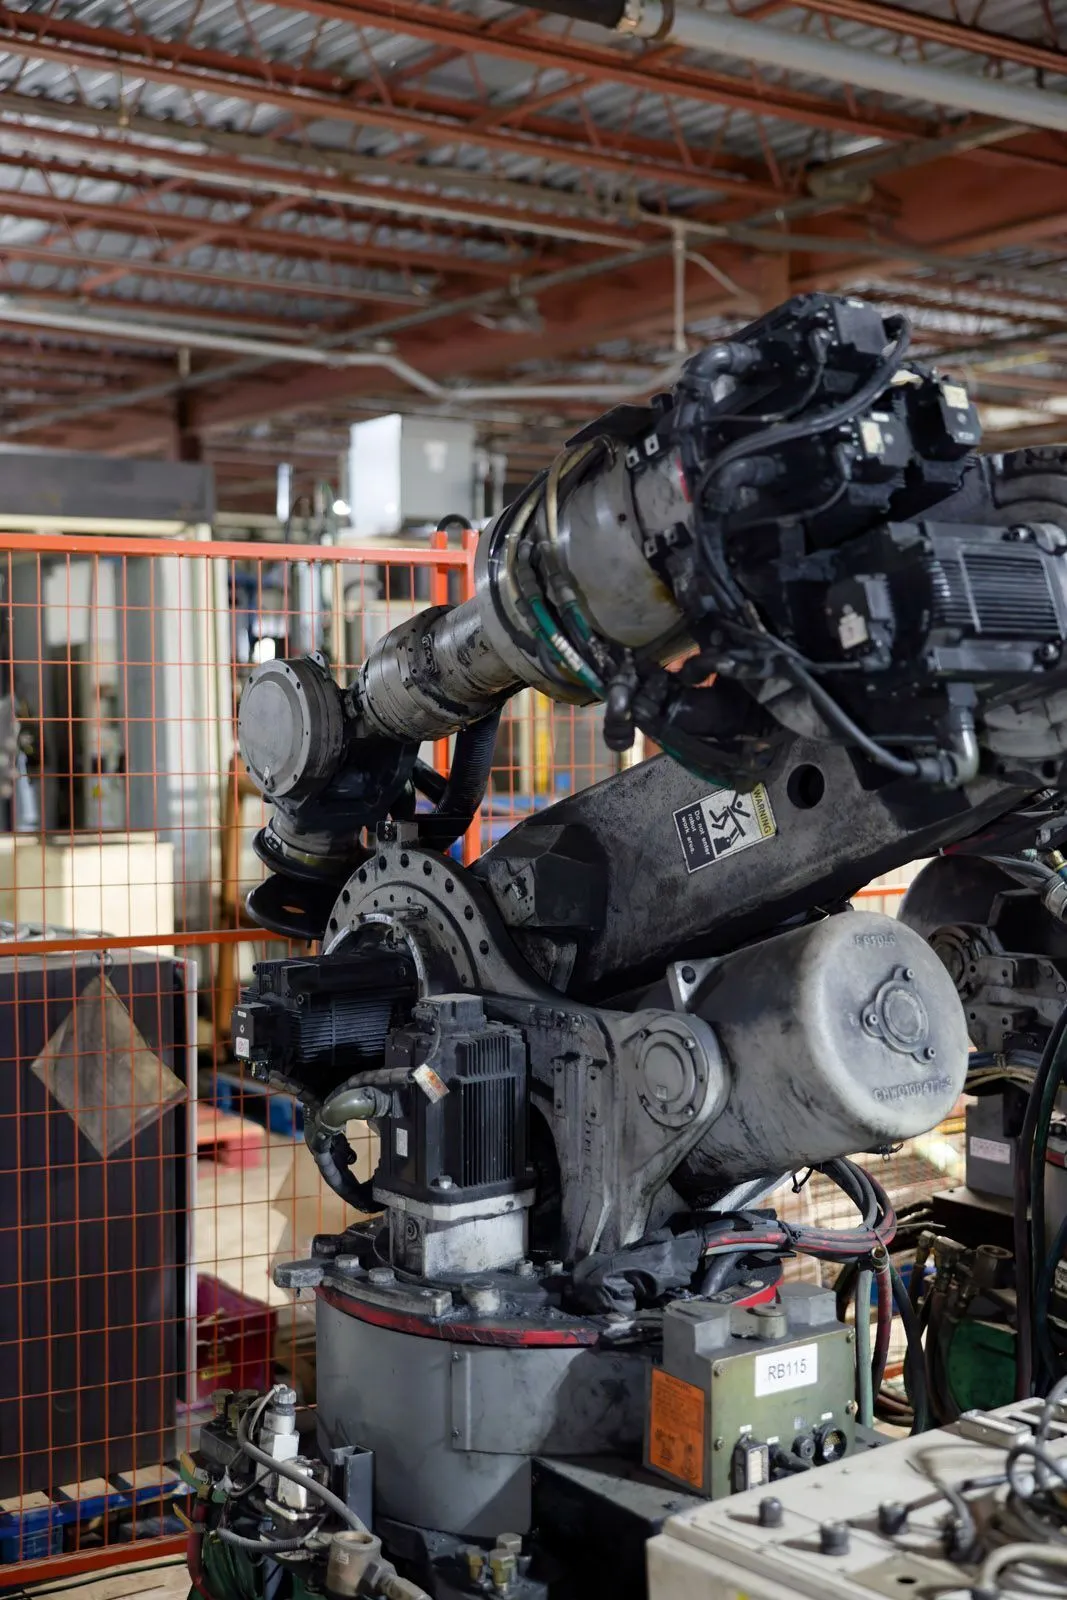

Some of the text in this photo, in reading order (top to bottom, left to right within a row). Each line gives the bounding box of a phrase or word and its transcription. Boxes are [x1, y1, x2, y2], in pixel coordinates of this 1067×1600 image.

[688, 813, 697, 832] robot
[753, 789, 772, 834] WARNING
[681, 816, 690, 834] work
[694, 809, 711, 856] Do not enter
[768, 1358, 807, 1381] RB115
